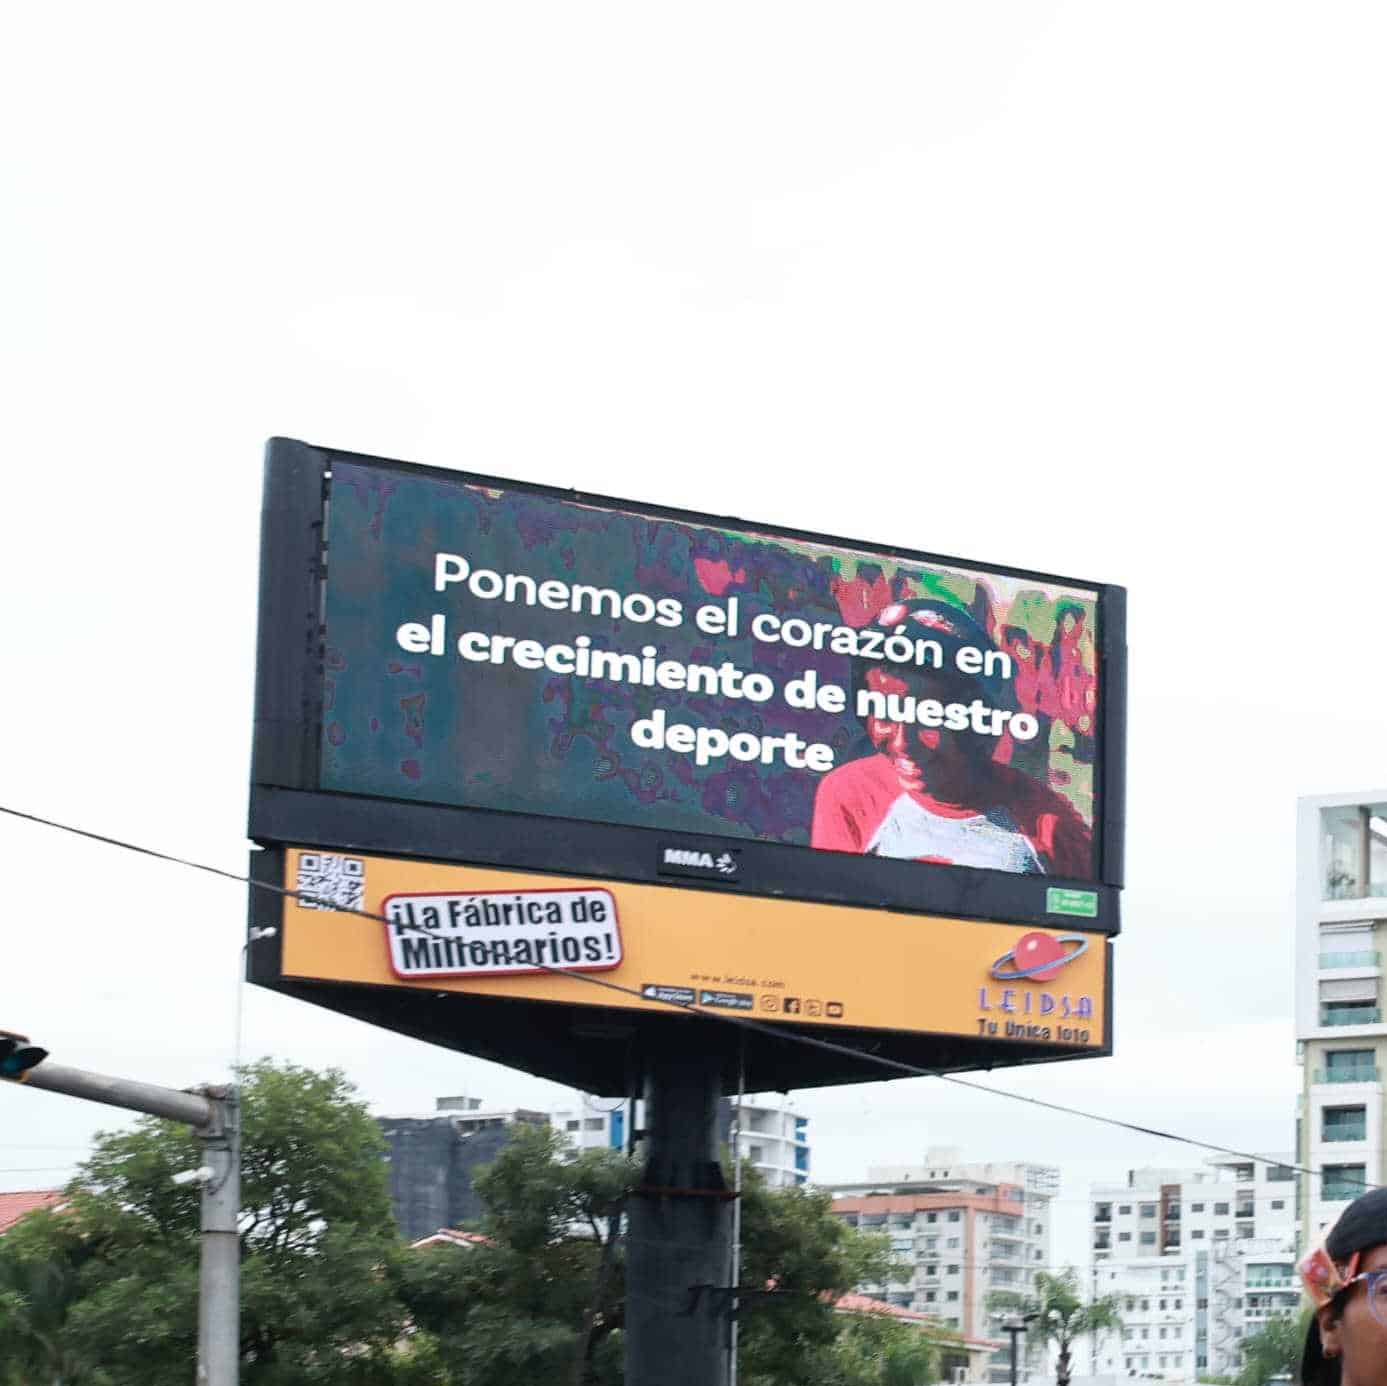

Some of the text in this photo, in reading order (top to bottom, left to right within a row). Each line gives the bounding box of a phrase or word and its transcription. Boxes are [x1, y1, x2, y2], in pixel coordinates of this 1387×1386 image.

[435, 552, 1012, 679] Ponemos el corazón en
[396, 614, 1039, 741] el crecimiento de nuestro
[631, 709, 834, 772] deporte
[664, 848, 714, 868] MMA
[447, 896, 562, 928] Fábrica
[571, 896, 607, 923] de
[401, 932, 615, 969] Millonarios!
[979, 987, 1093, 1019] LEIDSA
[977, 1018, 998, 1036] Tu
[1056, 1025, 1090, 1043] loto
